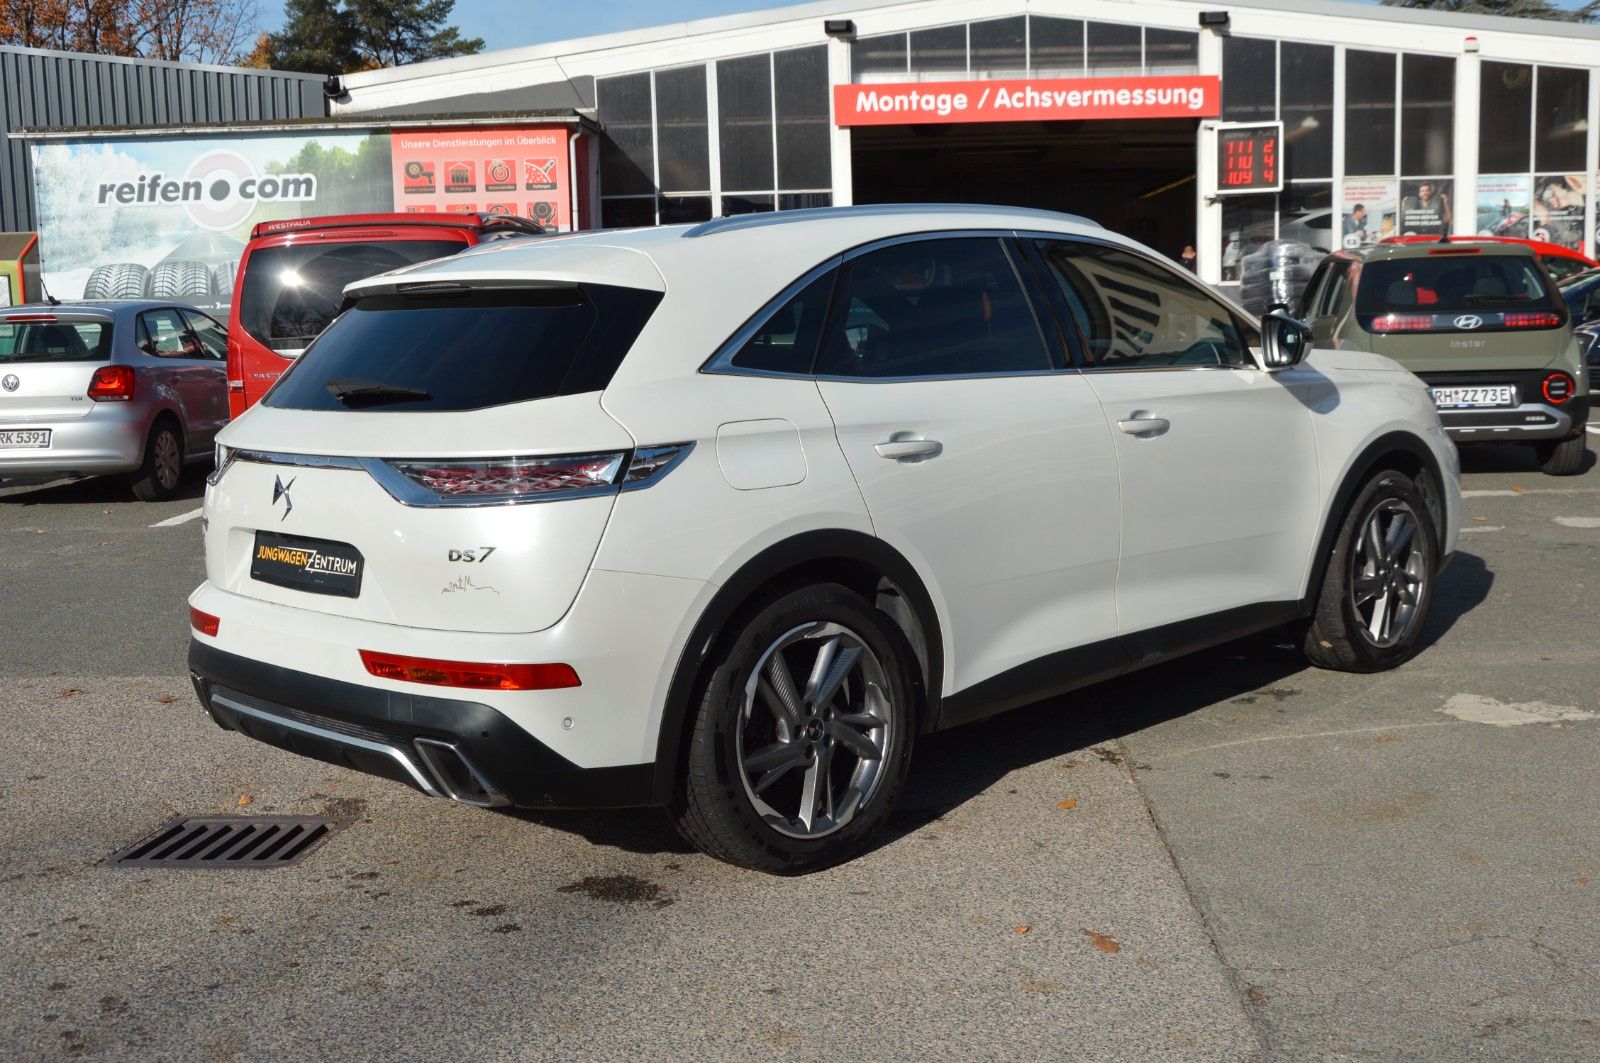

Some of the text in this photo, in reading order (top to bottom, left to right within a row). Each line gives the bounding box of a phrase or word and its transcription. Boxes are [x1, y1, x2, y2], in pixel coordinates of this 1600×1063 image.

[856, 86, 1204, 115] Montage / Achsvermessung
[401, 134, 557, 149] Unsere Dienstleistungen im Überblick
[268, 219, 311, 230] WESTFALIA
[1435, 390, 1453, 403] RH
[16, 432, 47, 444] 5391
